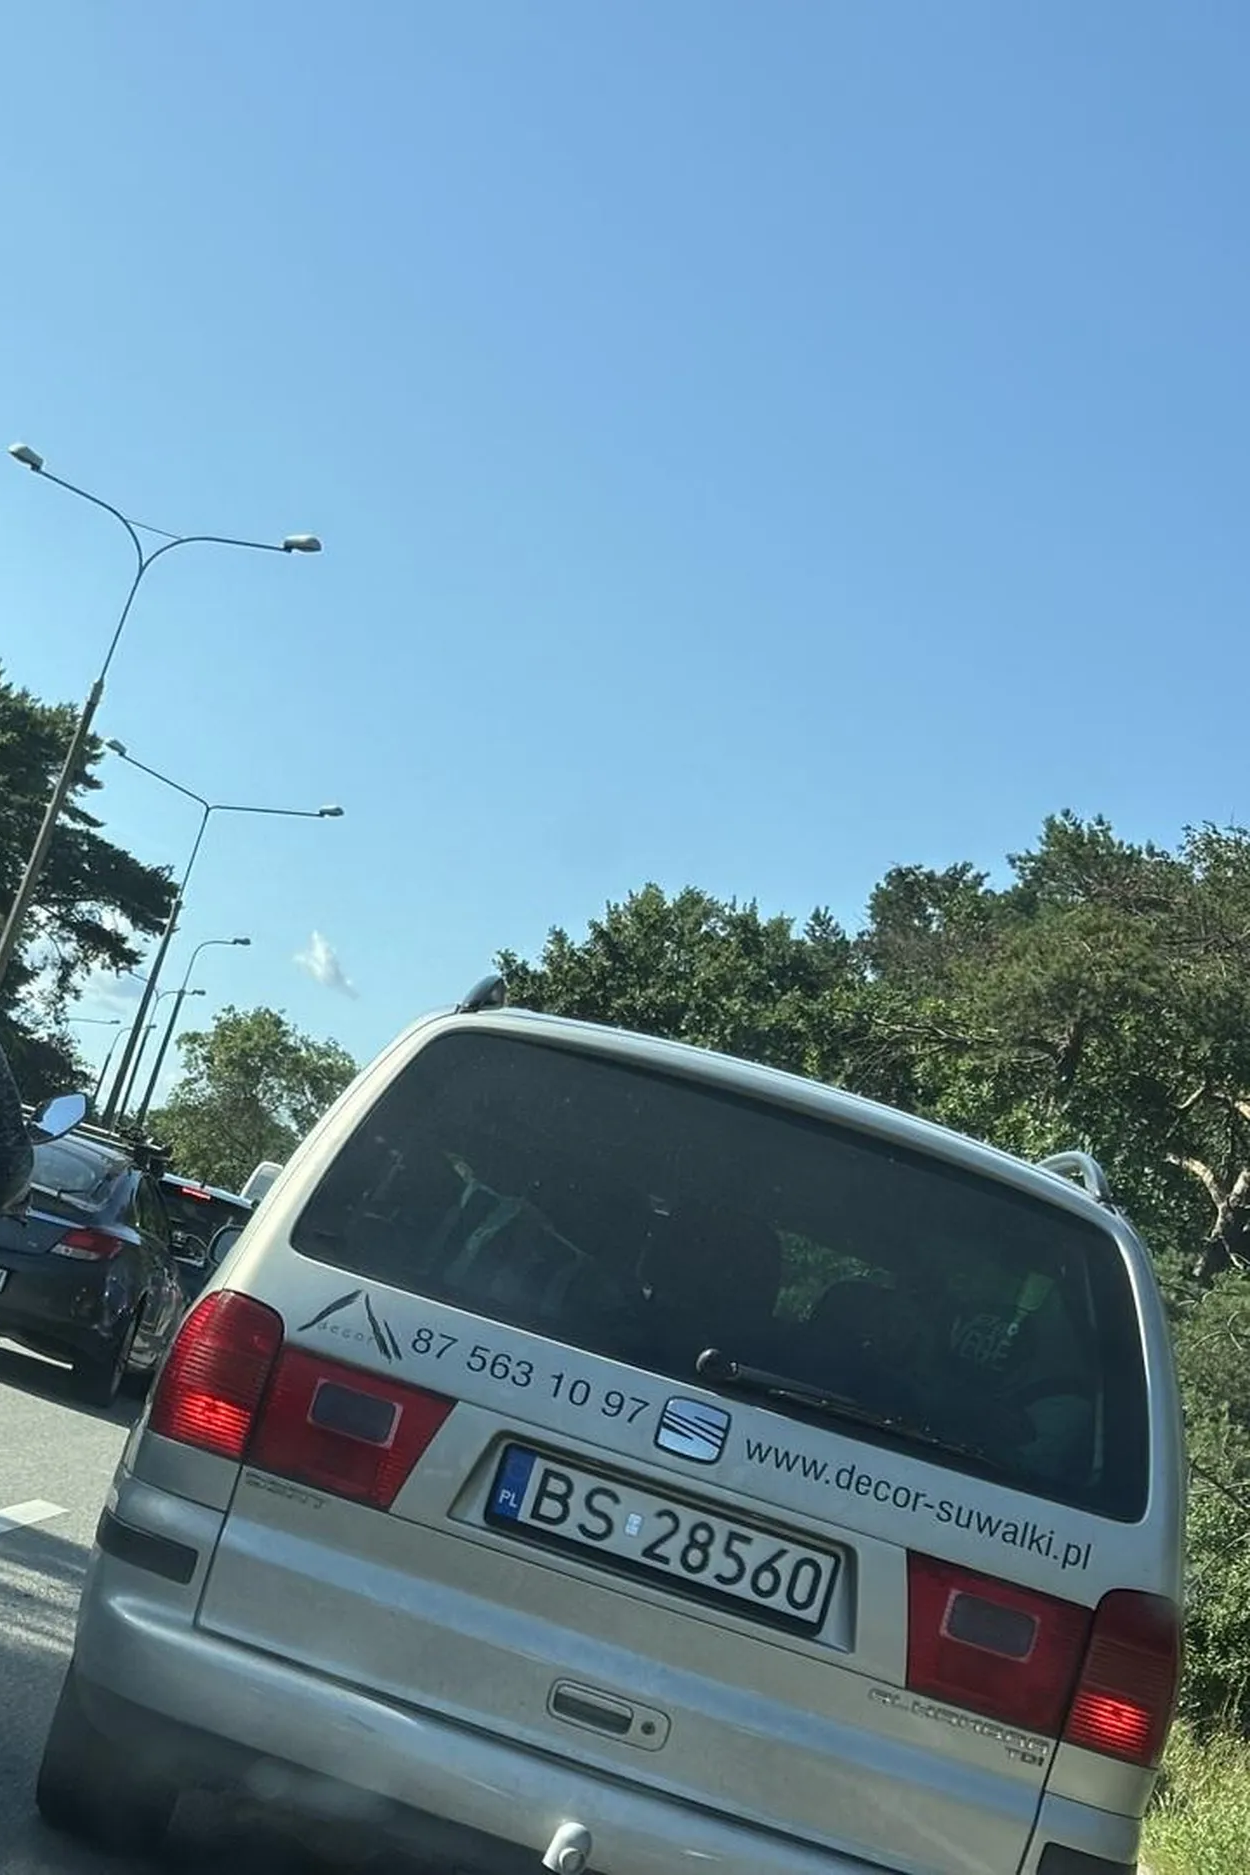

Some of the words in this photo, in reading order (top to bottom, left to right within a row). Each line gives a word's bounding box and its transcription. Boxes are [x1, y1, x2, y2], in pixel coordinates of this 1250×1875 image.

[411, 1328, 458, 1359] 87
[466, 1345, 534, 1387] 563
[550, 1372, 591, 1406] 10
[601, 1390, 649, 1433] 97
[498, 1488, 519, 1508] PL
[529, 1467, 622, 1542] BS
[641, 1508, 822, 1611] 28560
[745, 1438, 1092, 1570] www.decor-suwalki.pl
